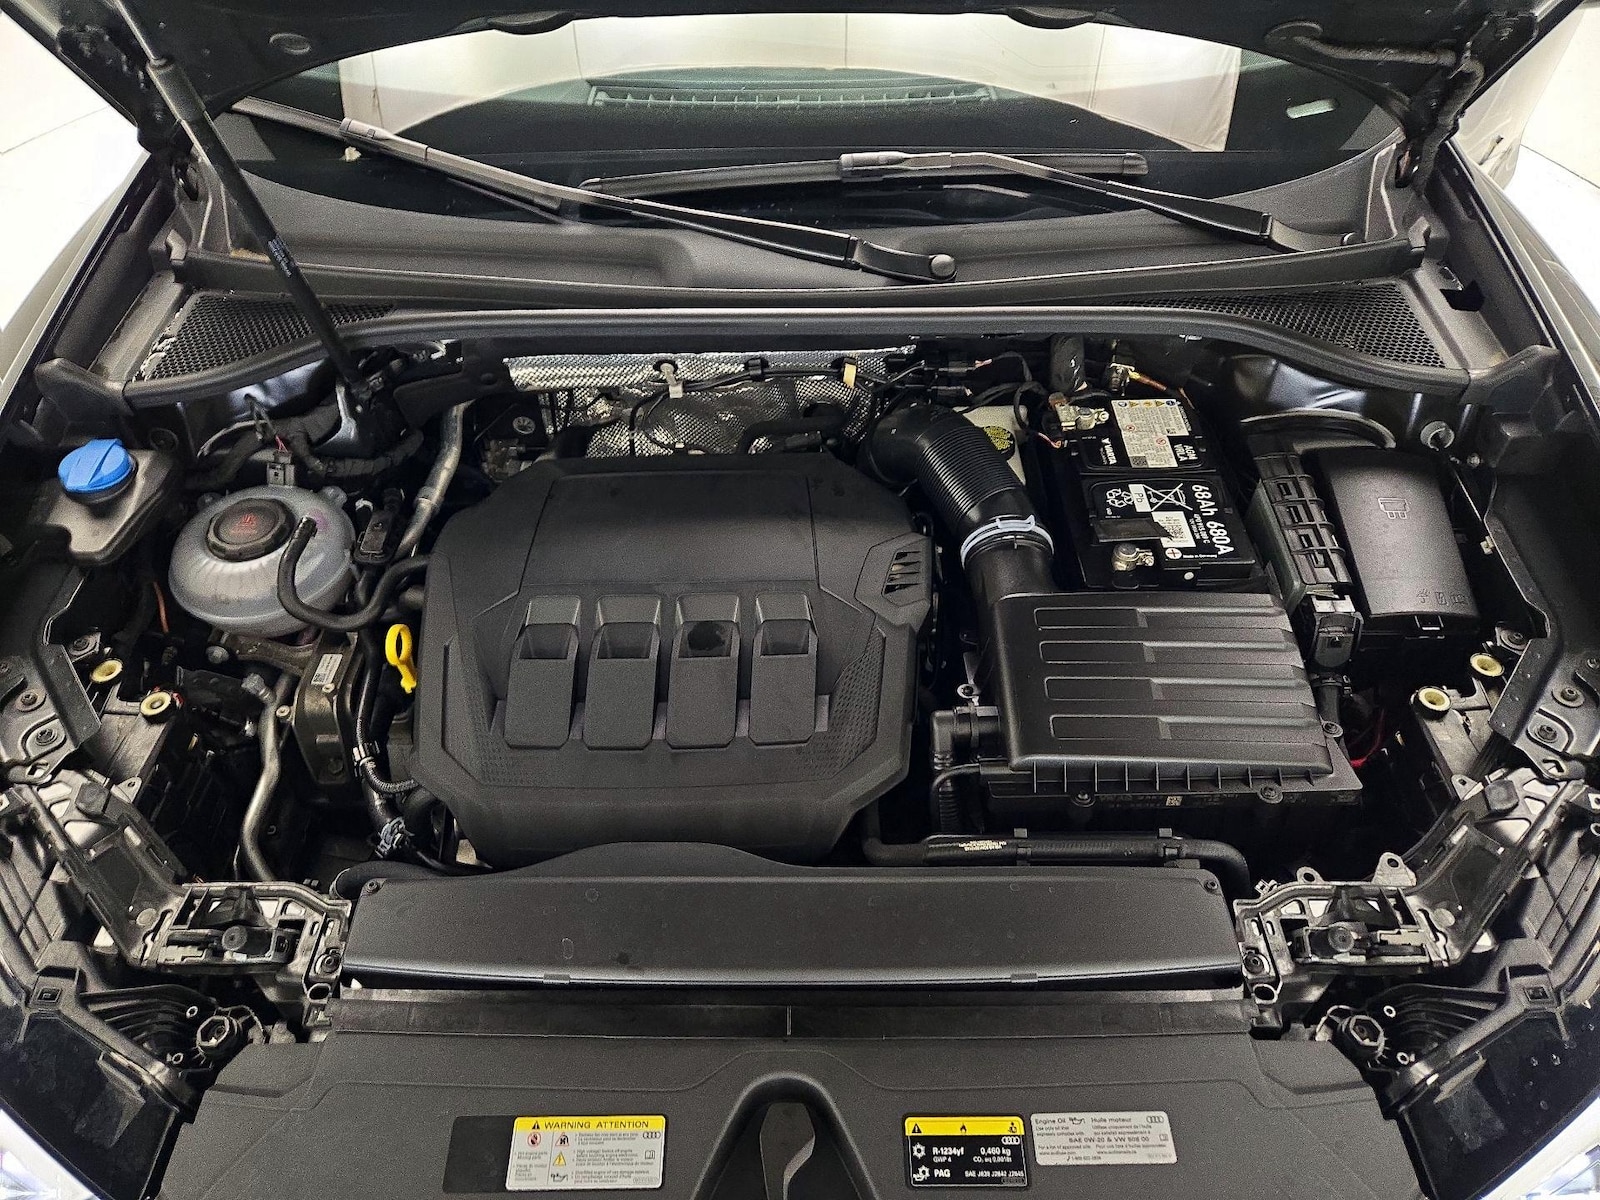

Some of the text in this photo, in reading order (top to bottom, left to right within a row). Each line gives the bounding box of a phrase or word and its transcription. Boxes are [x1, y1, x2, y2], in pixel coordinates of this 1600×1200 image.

[1104, 443, 1117, 465] VARTA
[1183, 445, 1198, 460] AGM
[1134, 492, 1144, 503] Pb
[1191, 484, 1218, 516] 68Ah
[1206, 521, 1235, 555] 680A
[544, 1120, 649, 1129] WARNING ATTENTION
[932, 1146, 965, 1157] R-1234yf
[979, 1146, 1012, 1157] 0,460 kg
[934, 1168, 951, 1178] PAG
[964, 1170, 977, 1178] SAE
